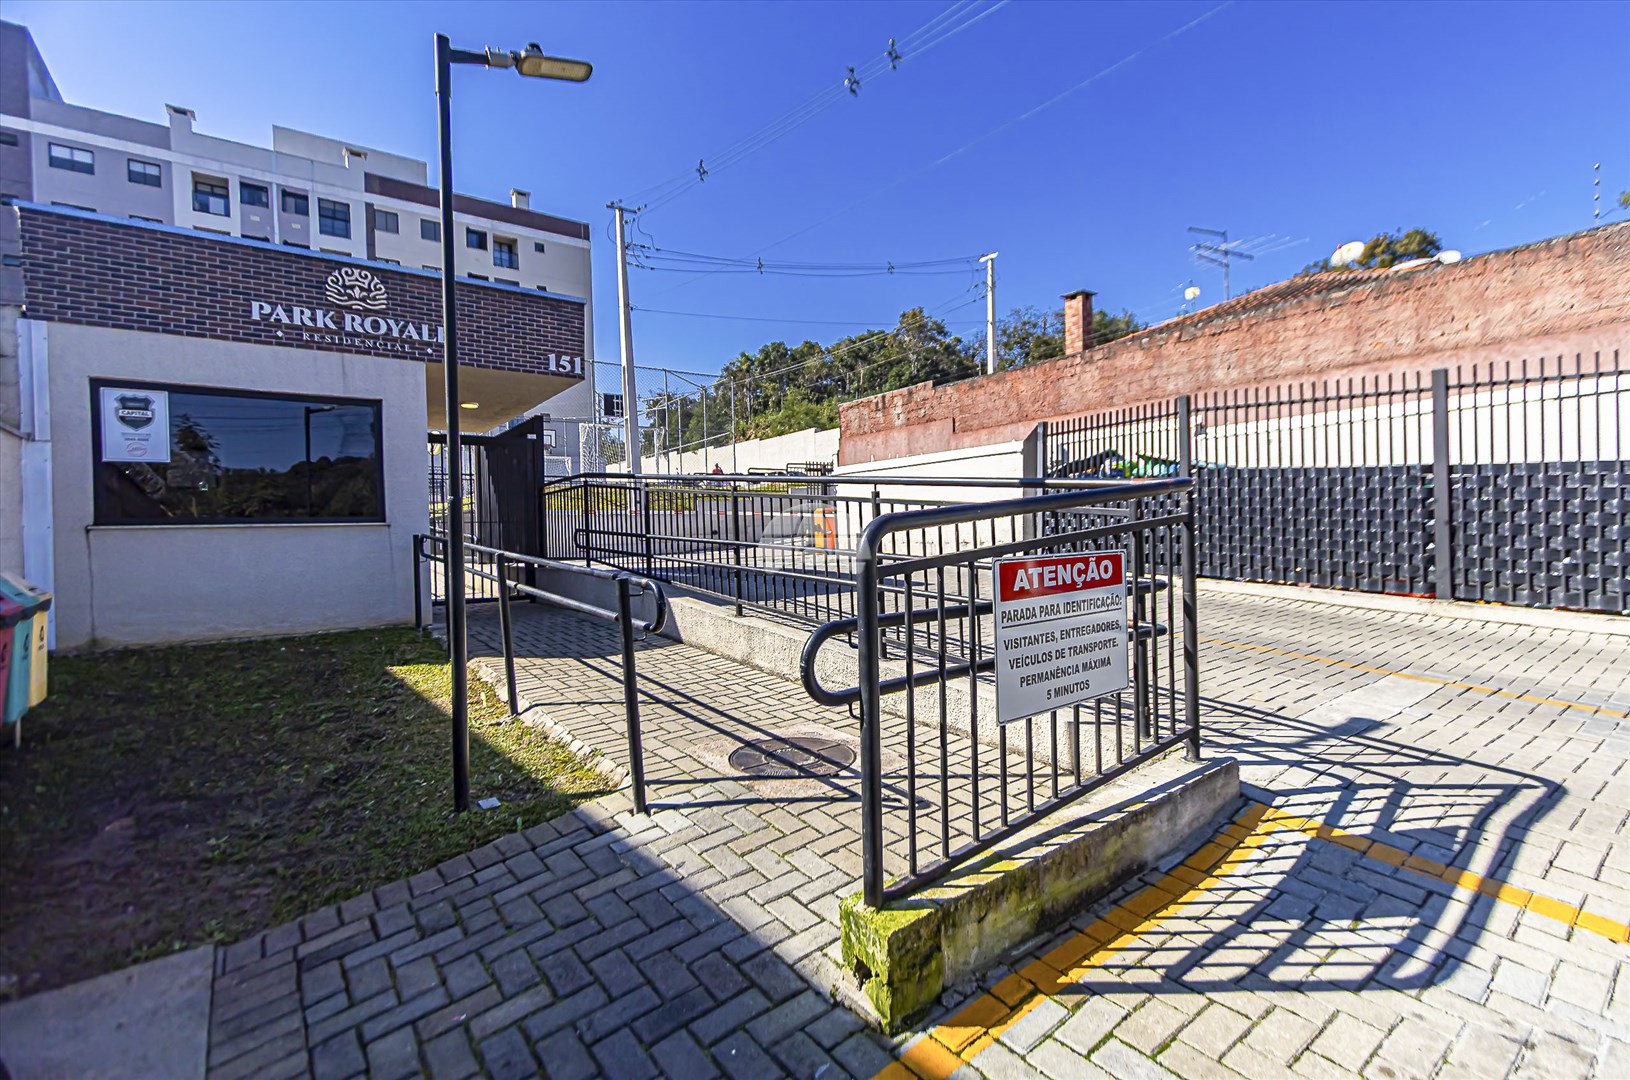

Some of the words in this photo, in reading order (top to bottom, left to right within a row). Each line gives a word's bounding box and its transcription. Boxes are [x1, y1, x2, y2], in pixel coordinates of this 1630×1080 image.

[251, 300, 338, 330] PARK
[302, 332, 412, 353] RESIDENCIAL
[547, 353, 582, 374] 151
[1013, 557, 1113, 589] ATENÇÃO
[1001, 606, 1037, 624] PARADA
[1039, 602, 1061, 618] PARA
[1063, 593, 1122, 614] IDENTIFICAÇÃO:
[1003, 631, 1058, 651] VISITANTES,
[1060, 620, 1122, 641] ENTREGADORES,
[1008, 651, 1053, 670] VEÍCULOS
[1055, 649, 1066, 660] DE
[1067, 637, 1119, 656] TRANSPORTE.
[1019, 663, 1080, 688] PERMANÊNCIA
[1081, 655, 1112, 673] MÁXIMA
[1046, 689, 1052, 700] 5
[1053, 679, 1090, 698] MINUTOS
